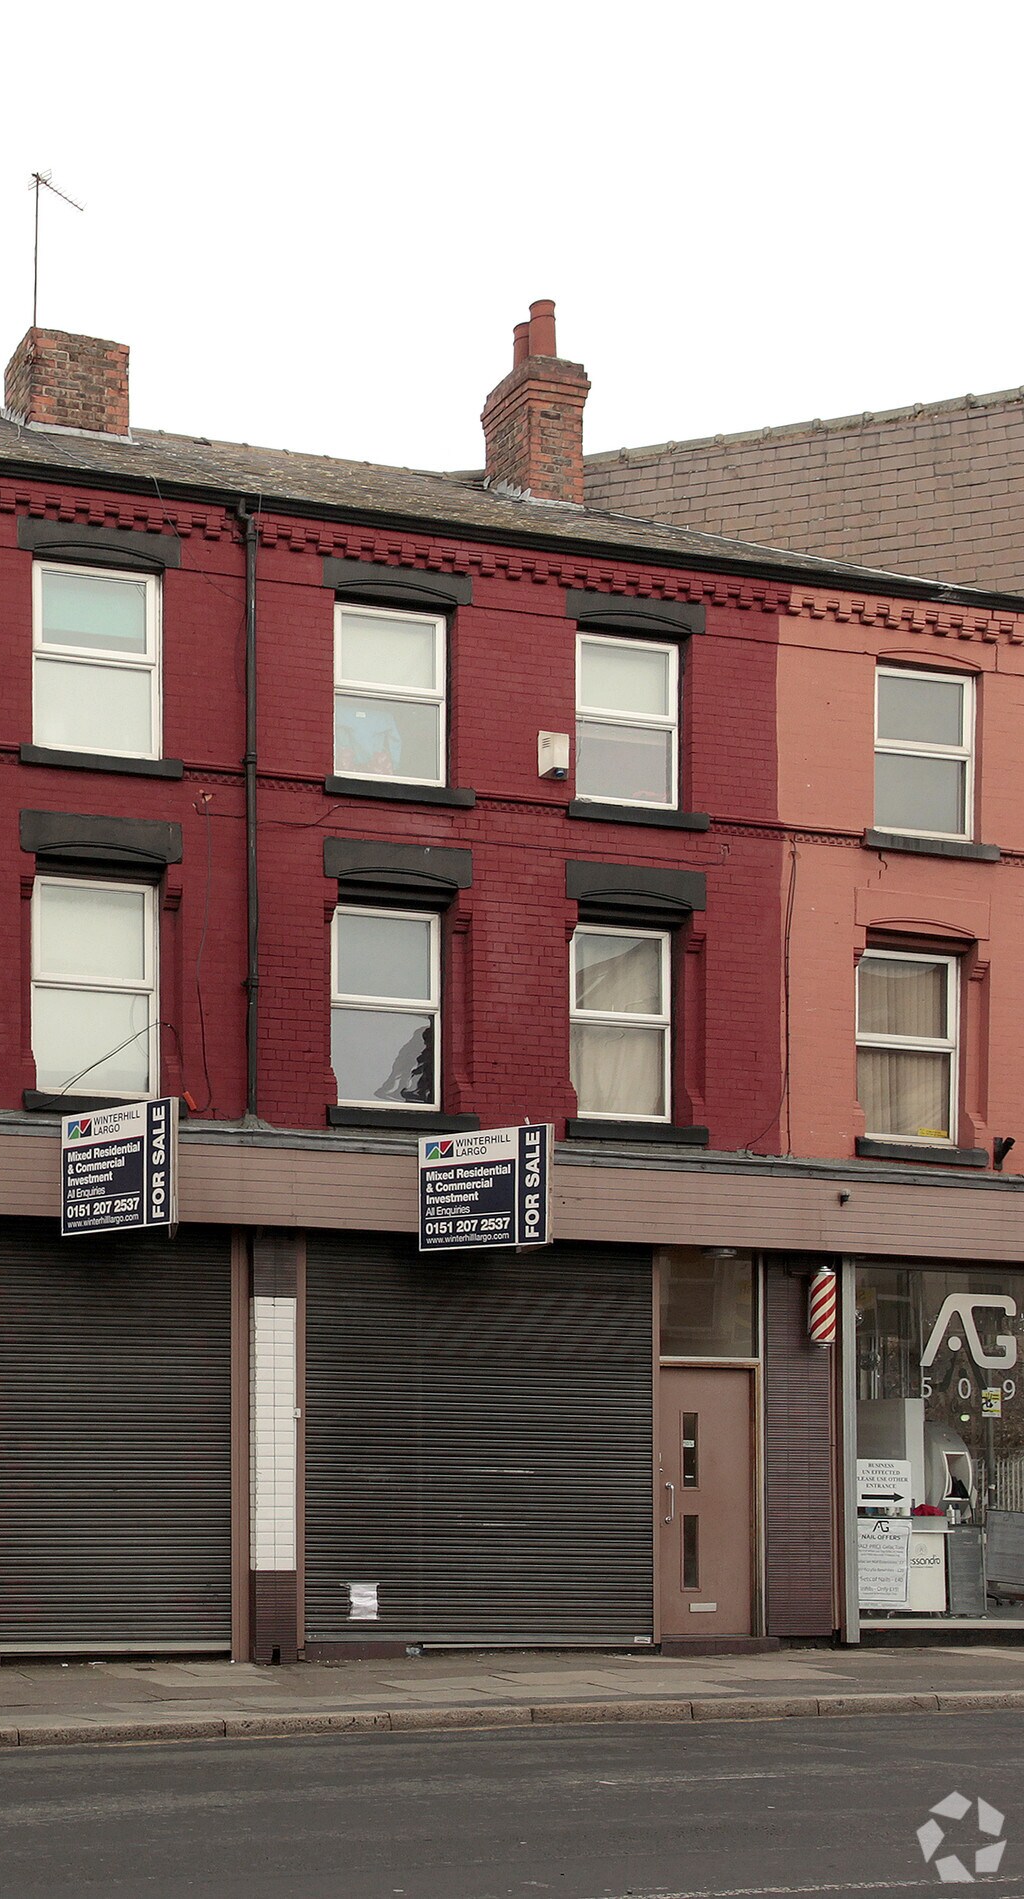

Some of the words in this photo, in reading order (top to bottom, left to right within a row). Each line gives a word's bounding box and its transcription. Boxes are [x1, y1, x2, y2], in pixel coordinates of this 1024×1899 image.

[94, 1110, 140, 1126] WINTERHILL
[94, 1124, 120, 1136] LARGO
[152, 1105, 166, 1165] SALE
[456, 1134, 510, 1148] WINTERHILL
[68, 1148, 92, 1162] Mixed
[94, 1141, 140, 1159] Residential
[456, 1146, 487, 1157] LARGO
[525, 1131, 540, 1188] SALE
[68, 1164, 74, 1174] &
[76, 1158, 124, 1173] Commercial
[426, 1169, 454, 1182] Mixed
[456, 1164, 510, 1179] Residential
[68, 1171, 113, 1186] Investment
[426, 1184, 433, 1193] &
[436, 1178, 492, 1192] Commercial
[67, 1188, 76, 1199] All
[76, 1186, 106, 1198] Enquiries
[152, 1171, 166, 1218] FOR
[426, 1192, 478, 1204] Investment
[67, 1203, 90, 1218] 0151
[94, 1201, 111, 1216] 207
[114, 1198, 140, 1213] 2537
[426, 1206, 435, 1216] All
[436, 1206, 470, 1217] Enquiries
[525, 1194, 540, 1238] FOR
[426, 1222, 452, 1234] 0151
[456, 1220, 478, 1233] 207
[480, 1217, 510, 1231] 2537
[426, 1232, 509, 1244] www.winterhilllargo.com
[920, 1293, 1017, 1370] AG
[910, 1554, 940, 1566] ssandro
